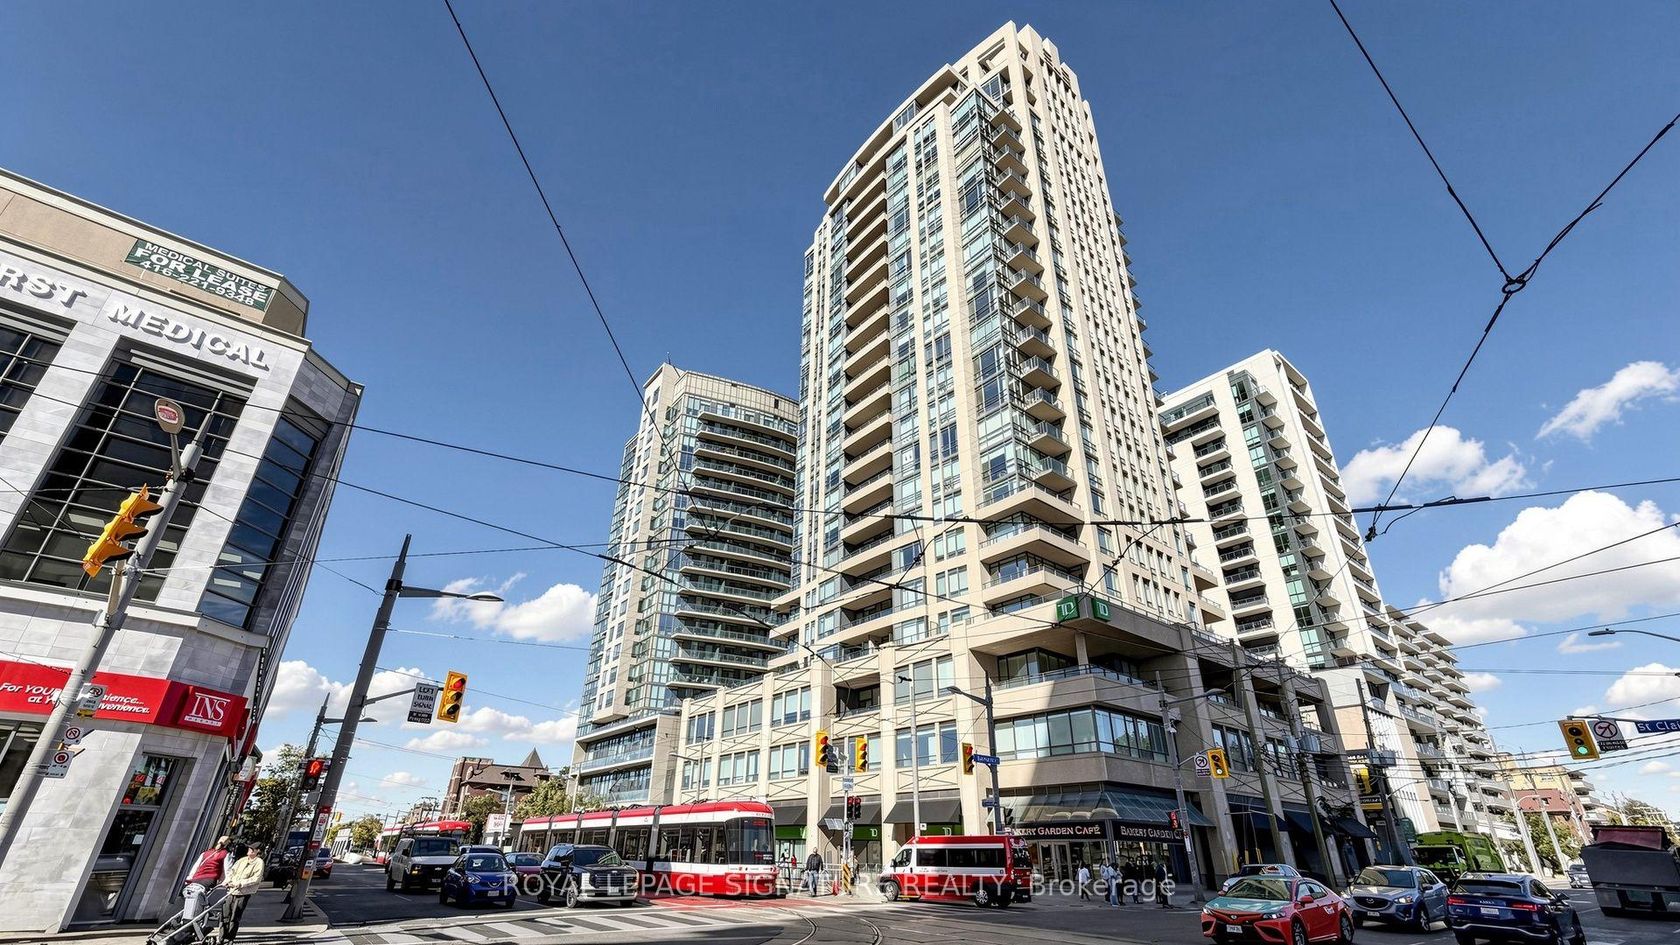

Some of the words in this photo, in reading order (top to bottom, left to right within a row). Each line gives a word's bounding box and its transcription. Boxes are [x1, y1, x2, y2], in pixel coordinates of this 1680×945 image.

[134, 247, 187, 274] FOR
[192, 268, 268, 303] LEASE
[145, 242, 212, 273] MEDICAL
[215, 268, 267, 292] SUITES
[140, 260, 255, 306] 416-221-9348
[107, 301, 269, 371] MEDICAL
[1057, 601, 1074, 616] TD
[0, 682, 23, 692] For
[28, 696, 42, 704] at
[189, 695, 227, 721] INS
[1637, 722, 1651, 731] St
[1038, 826, 1074, 836] GARDEN
[1076, 824, 1100, 835] CAFÉ
